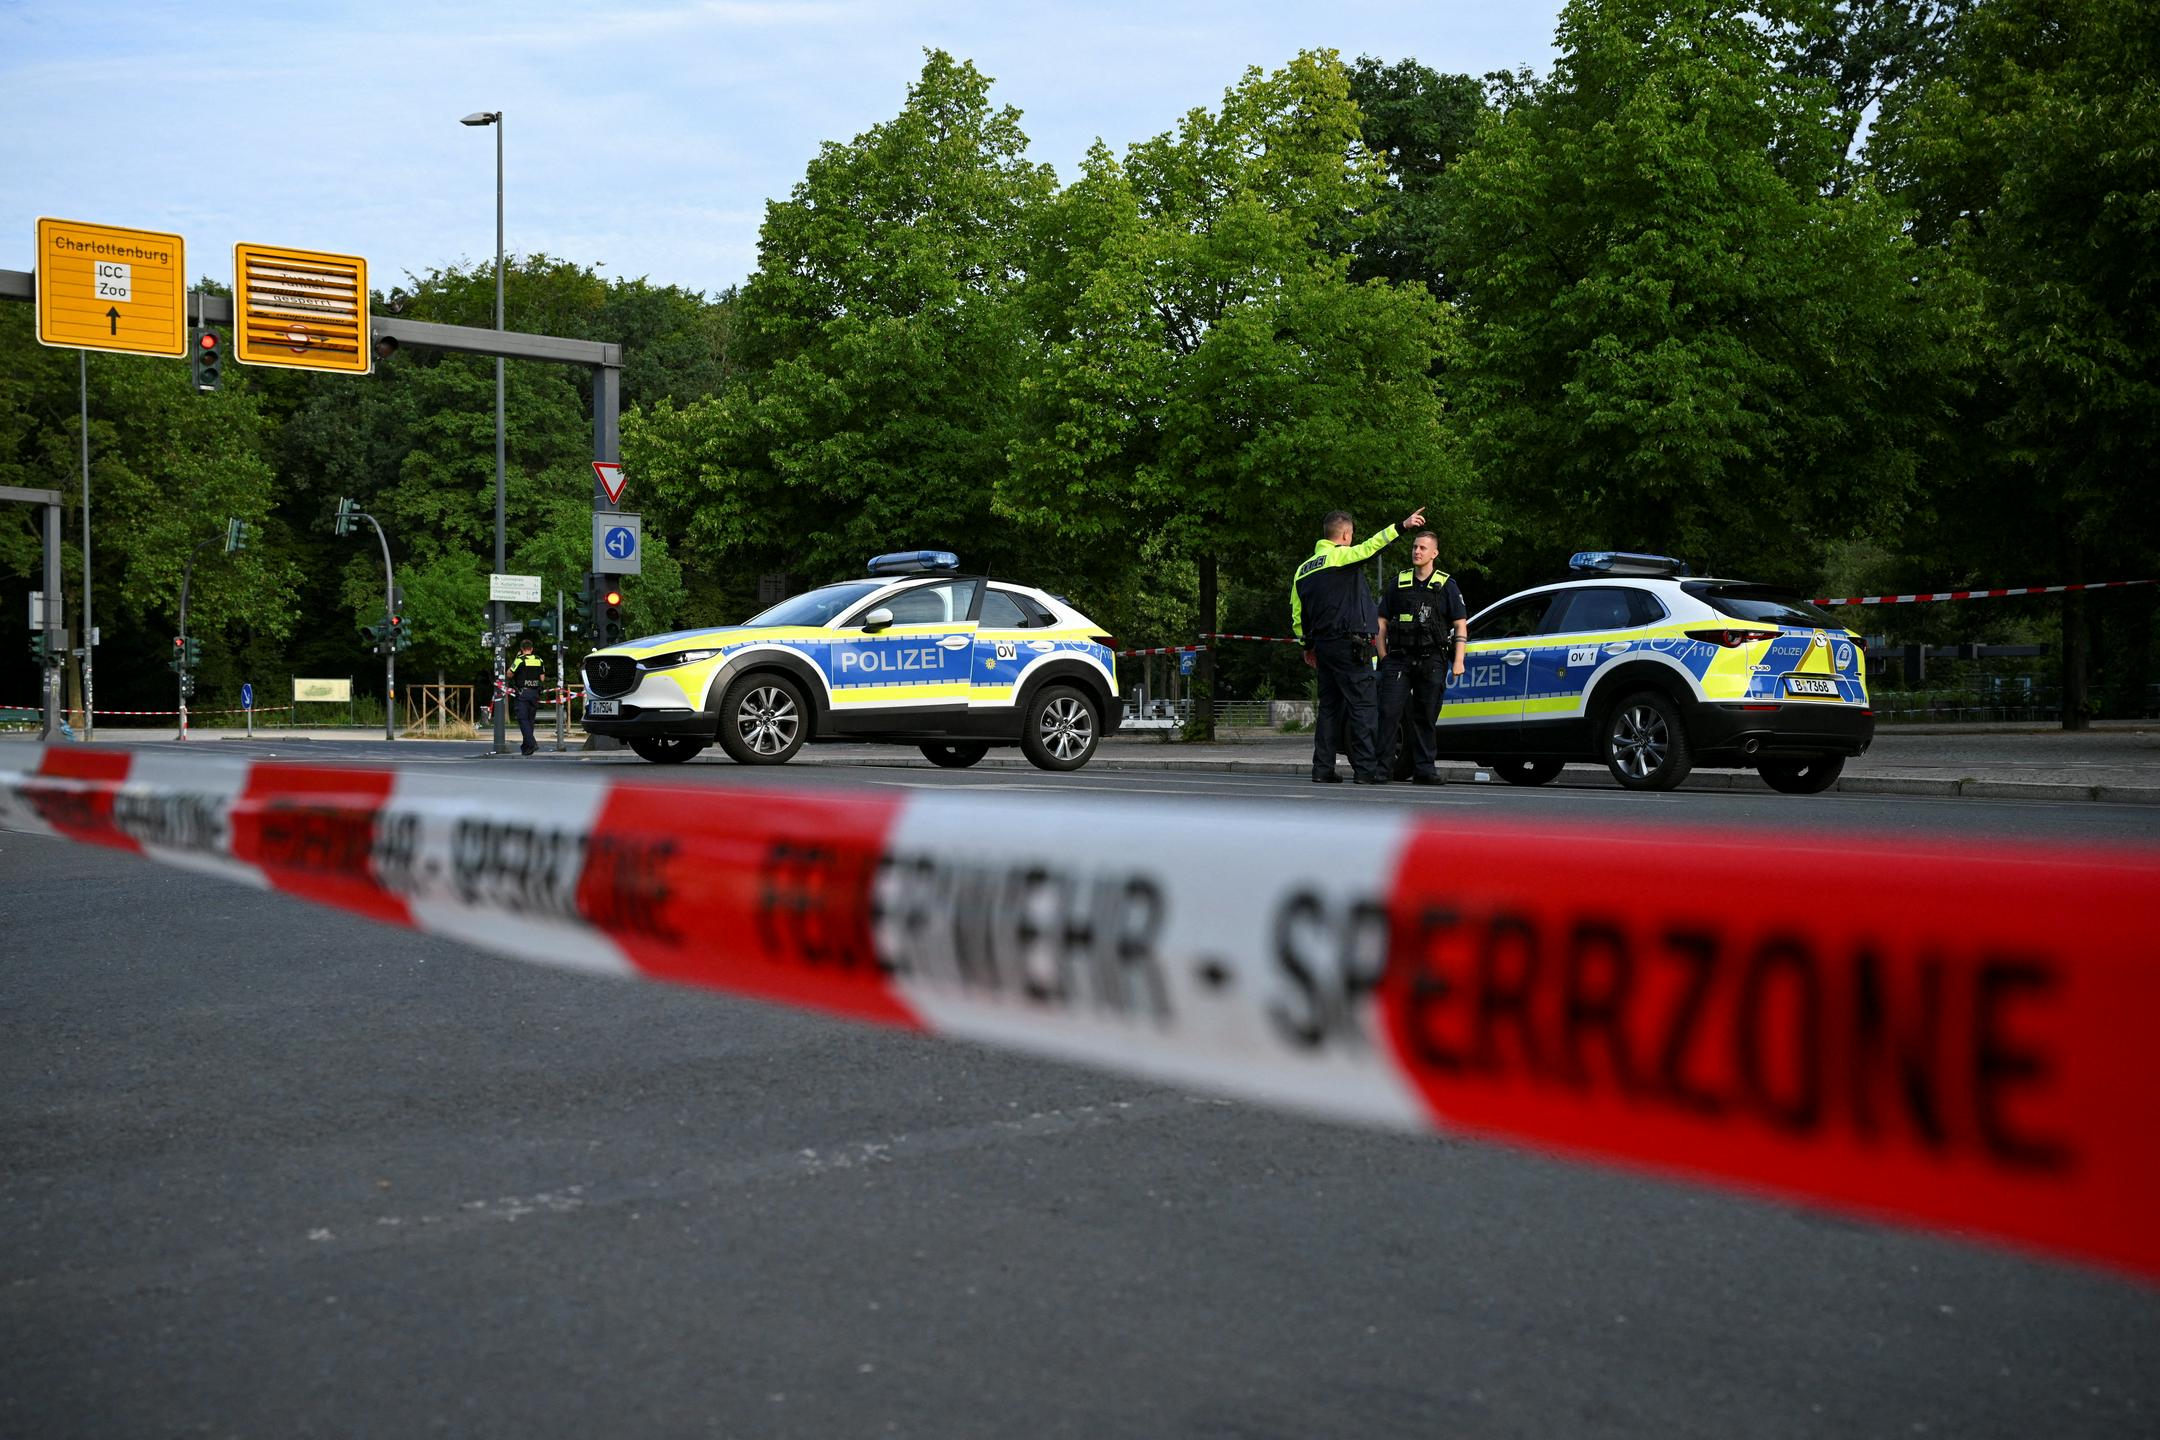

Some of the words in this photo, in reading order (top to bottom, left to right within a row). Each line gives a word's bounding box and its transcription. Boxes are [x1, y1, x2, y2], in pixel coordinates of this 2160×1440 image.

[55, 236, 168, 265] Charlottenburg
[99, 264, 123, 279] ICC
[100, 282, 127, 297] Zoo
[1300, 555, 1326, 574] OLIZEI
[997, 645, 1015, 658] OV
[1570, 652, 1583, 662] OV
[1692, 645, 1715, 657] 110
[1772, 646, 1803, 656] POLIZEI
[841, 647, 945, 673] POLIZEI
[1445, 664, 1506, 689] OLIZEI
[760, 840, 1174, 1032] FEUERWEHR
[1268, 882, 2078, 1174] SPERRZONE
